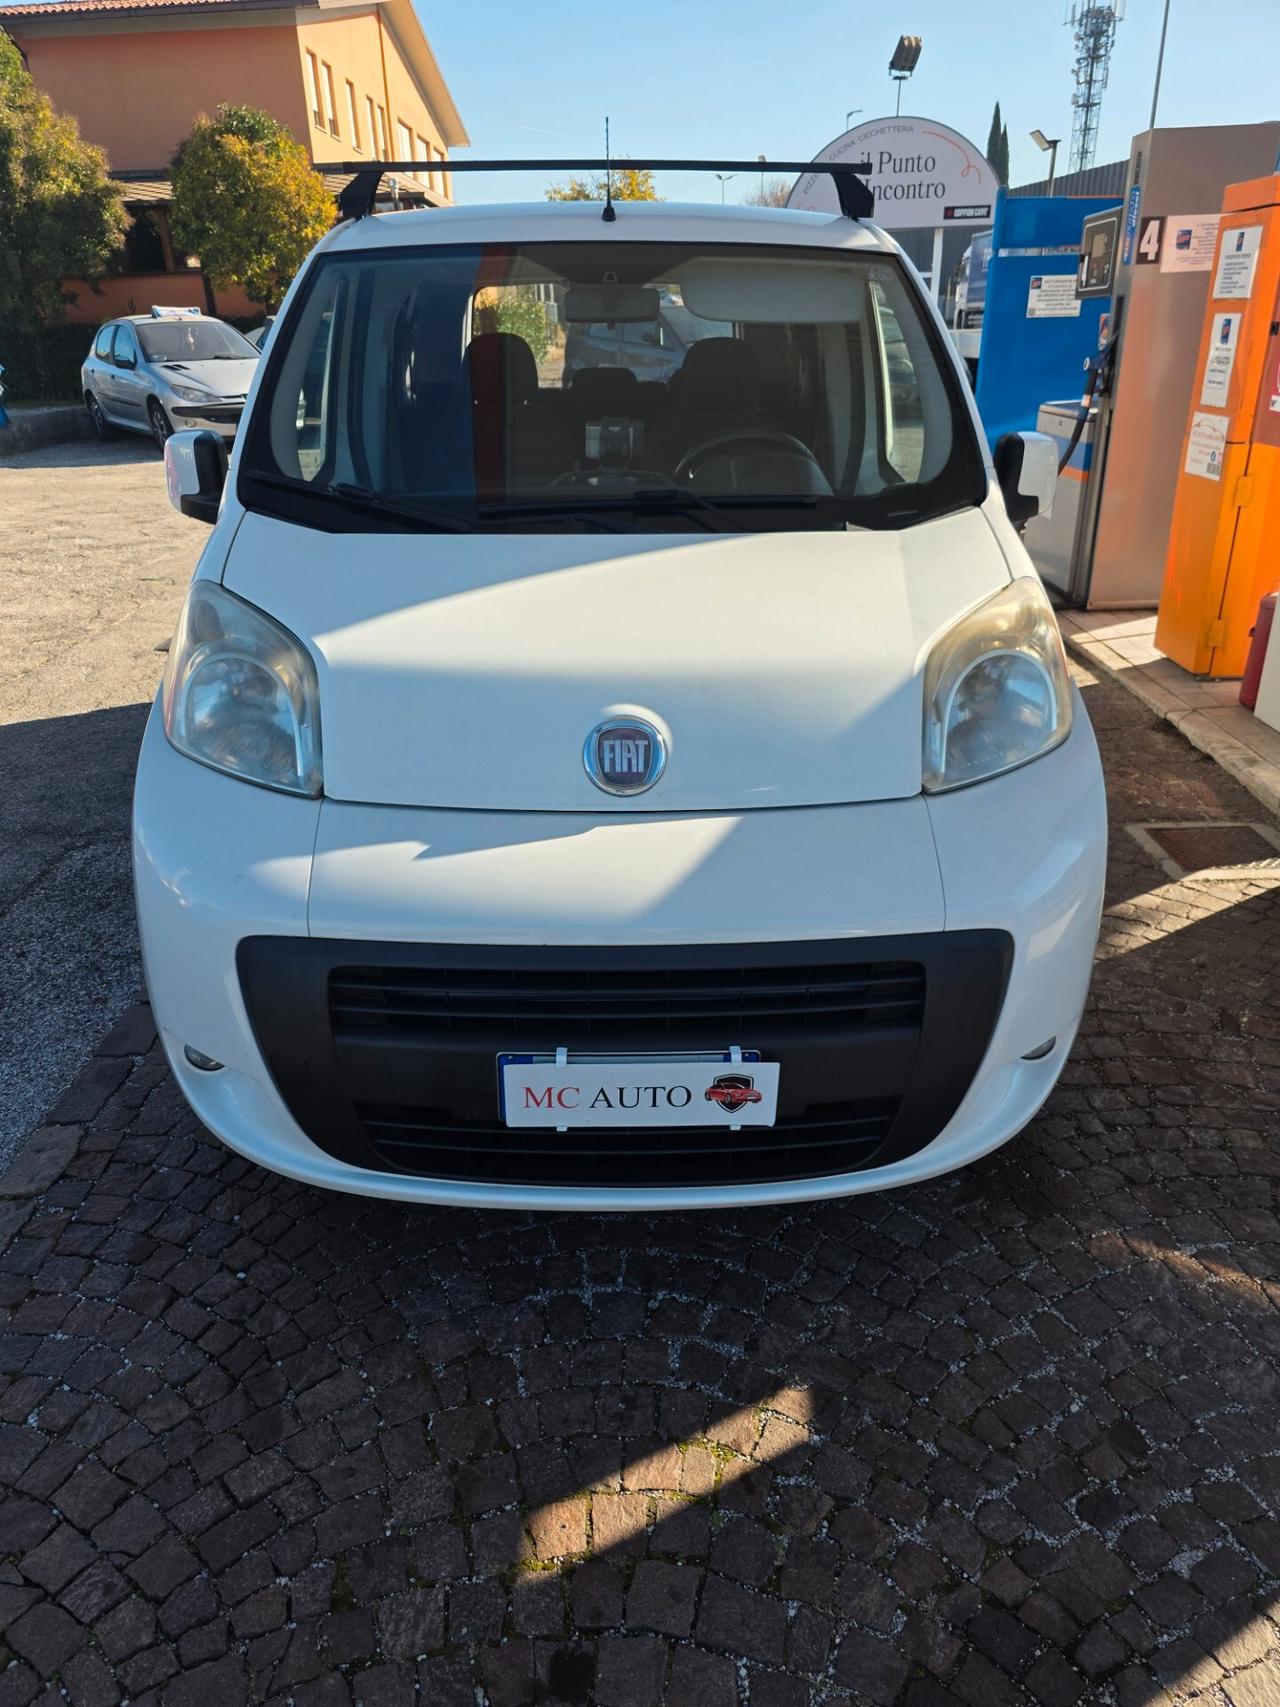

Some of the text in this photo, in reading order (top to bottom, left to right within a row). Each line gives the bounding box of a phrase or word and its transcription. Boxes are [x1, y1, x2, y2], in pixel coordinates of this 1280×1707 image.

[877, 151, 936, 174] Punto
[1139, 220, 1160, 261] 4
[603, 739, 649, 773] FIAT
[522, 1085, 692, 1109] MC AUTO
